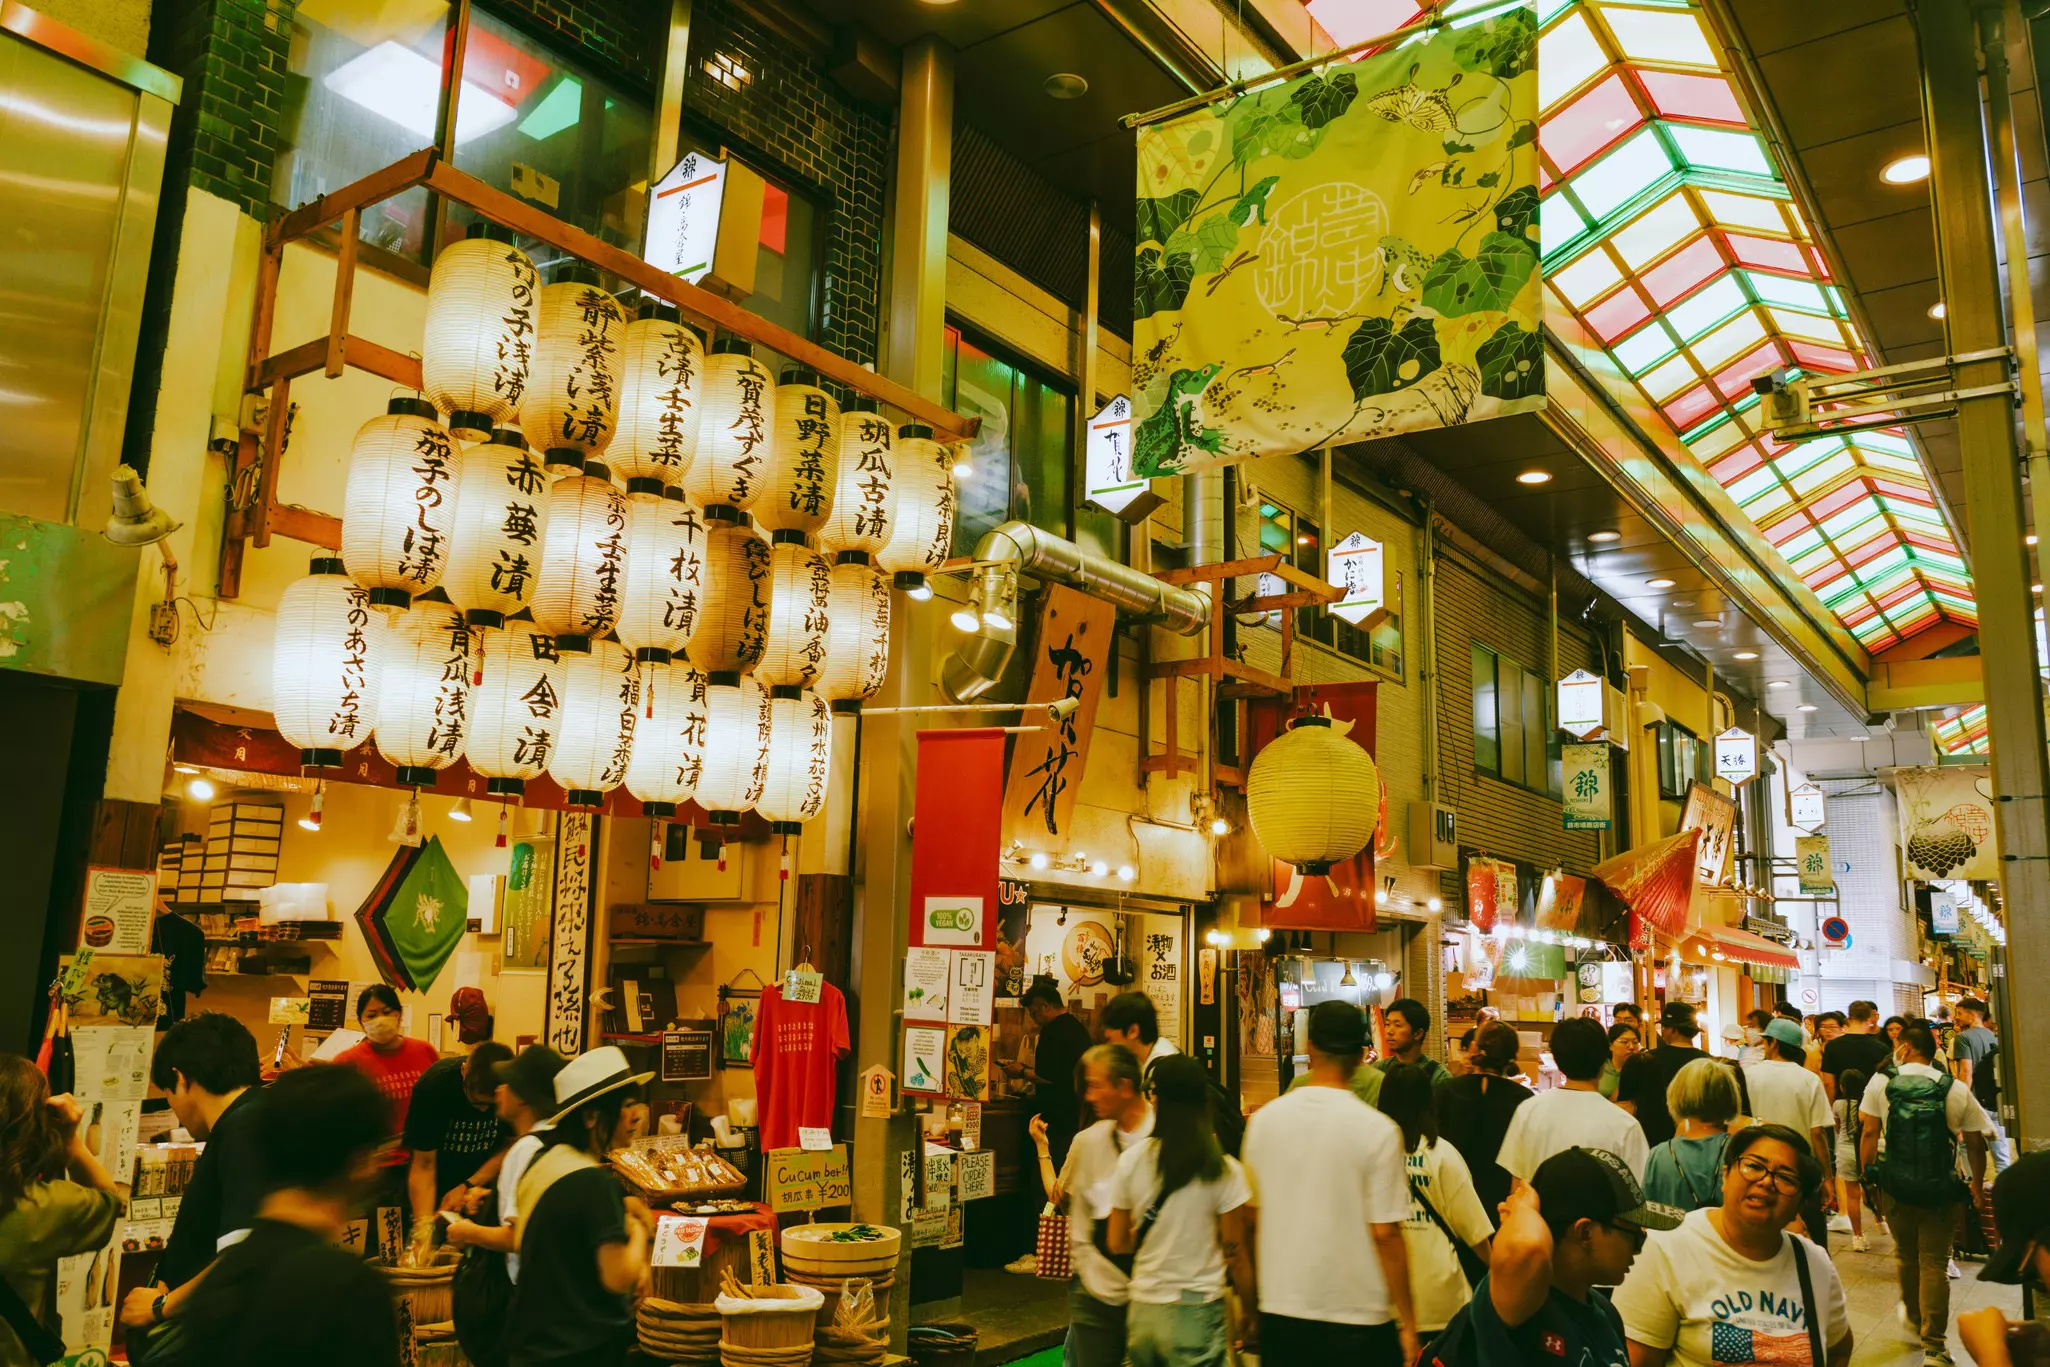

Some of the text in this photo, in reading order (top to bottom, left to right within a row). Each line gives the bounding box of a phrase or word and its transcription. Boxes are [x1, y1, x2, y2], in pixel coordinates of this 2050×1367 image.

[494, 249, 538, 406] 竹の子浅漬
[789, 393, 830, 516] 日野菜漬
[855, 418, 892, 539] 胡瓜古漬
[398, 427, 451, 585] 茄子のしば漬
[663, 508, 704, 637] 千枚漬
[328, 583, 369, 739] 京のあさいち漬
[426, 611, 477, 758] 青瓜浅漬
[513, 633, 560, 770] 田舎漬
[1569, 769, 1600, 805] 錦
[1802, 852, 1825, 877] 錦
[1146, 933, 1173, 951] 漬物
[1150, 963, 1177, 981] お酒
[961, 1153, 991, 1169] PLEASE
[962, 1167, 987, 1184] ORDER
[781, 1180, 850, 1203] 胡瓜串 ¥200
[965, 1179, 985, 1194] HERE
[1711, 1290, 1753, 1320] OLD
